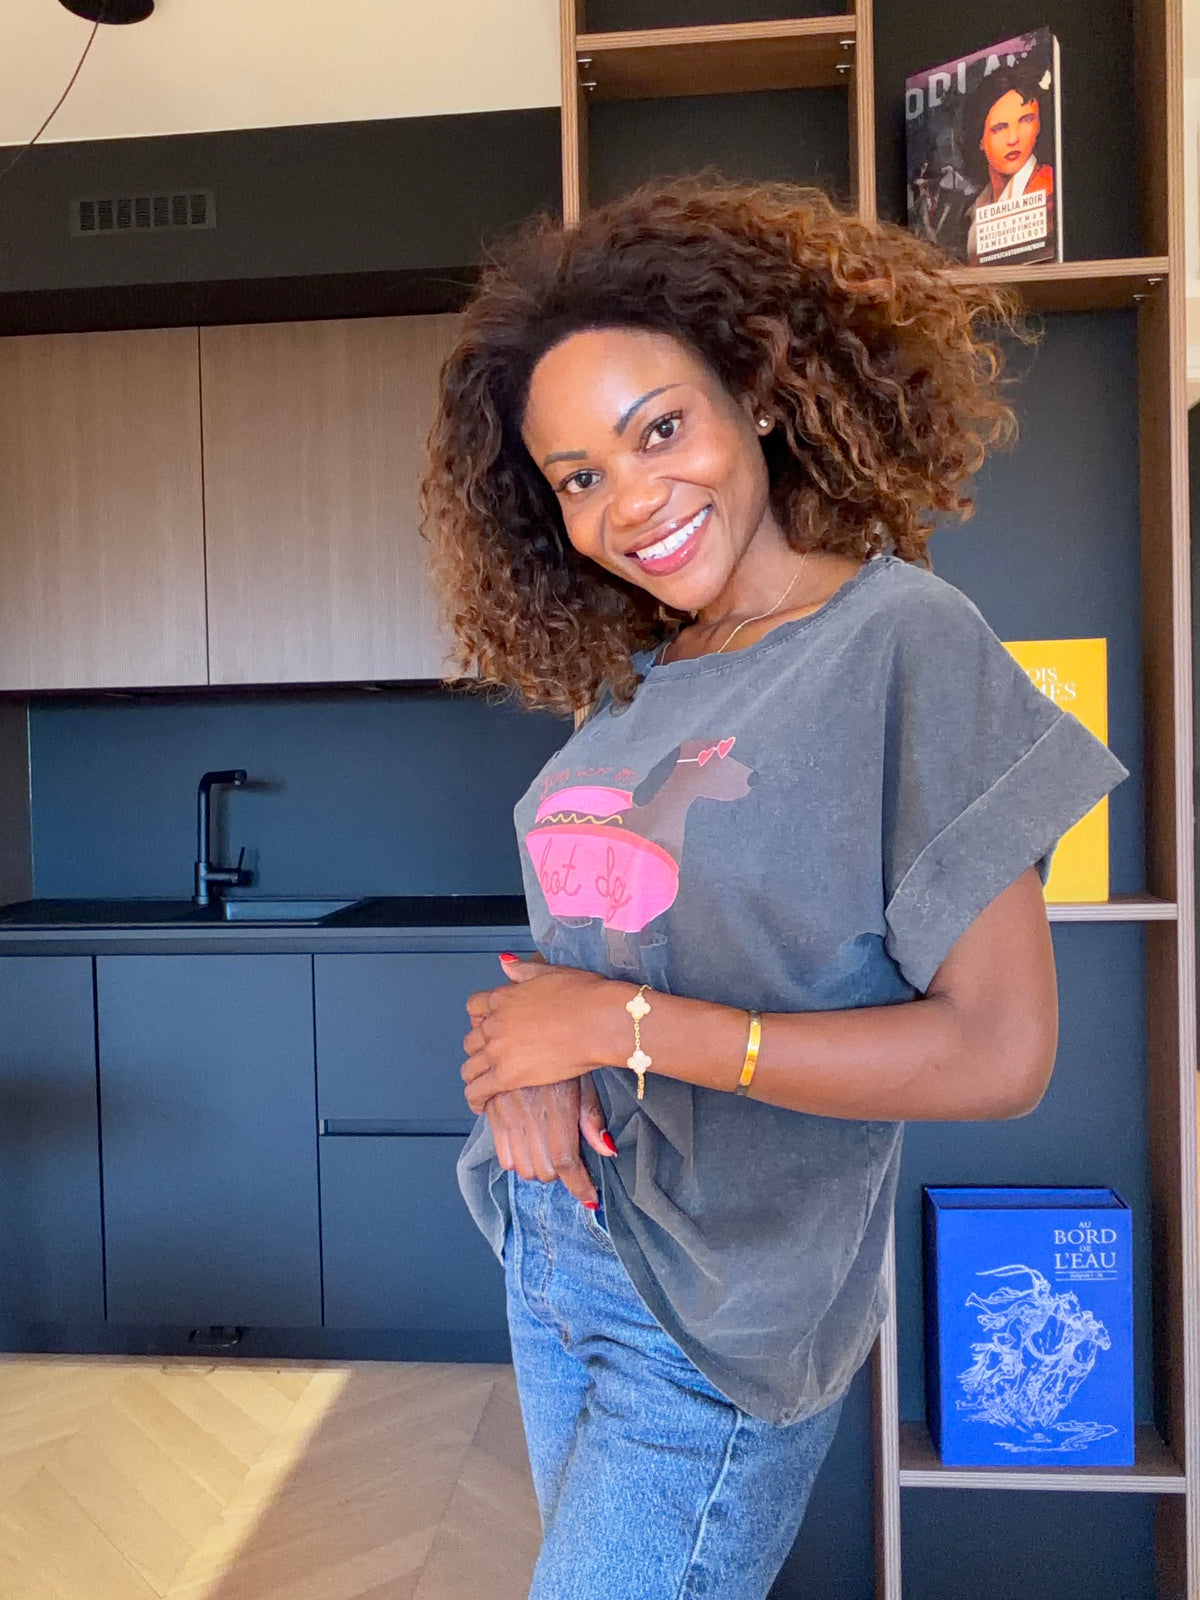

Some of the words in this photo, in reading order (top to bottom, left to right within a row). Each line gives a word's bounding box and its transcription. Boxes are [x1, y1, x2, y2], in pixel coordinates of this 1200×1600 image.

[979, 209, 989, 220] LE
[990, 200, 1020, 217] DAHLIA
[1022, 193, 1043, 208] NOIR
[979, 221, 1007, 234] MILES
[1017, 219, 1044, 232] FINCHER
[979, 236, 1008, 251] JAMES
[1011, 227, 1044, 242] ELLROY
[540, 838, 582, 897] hot
[1078, 1221, 1092, 1229] AU
[1054, 1228, 1117, 1245] BORD
[1054, 1252, 1117, 1269] L'EAU
